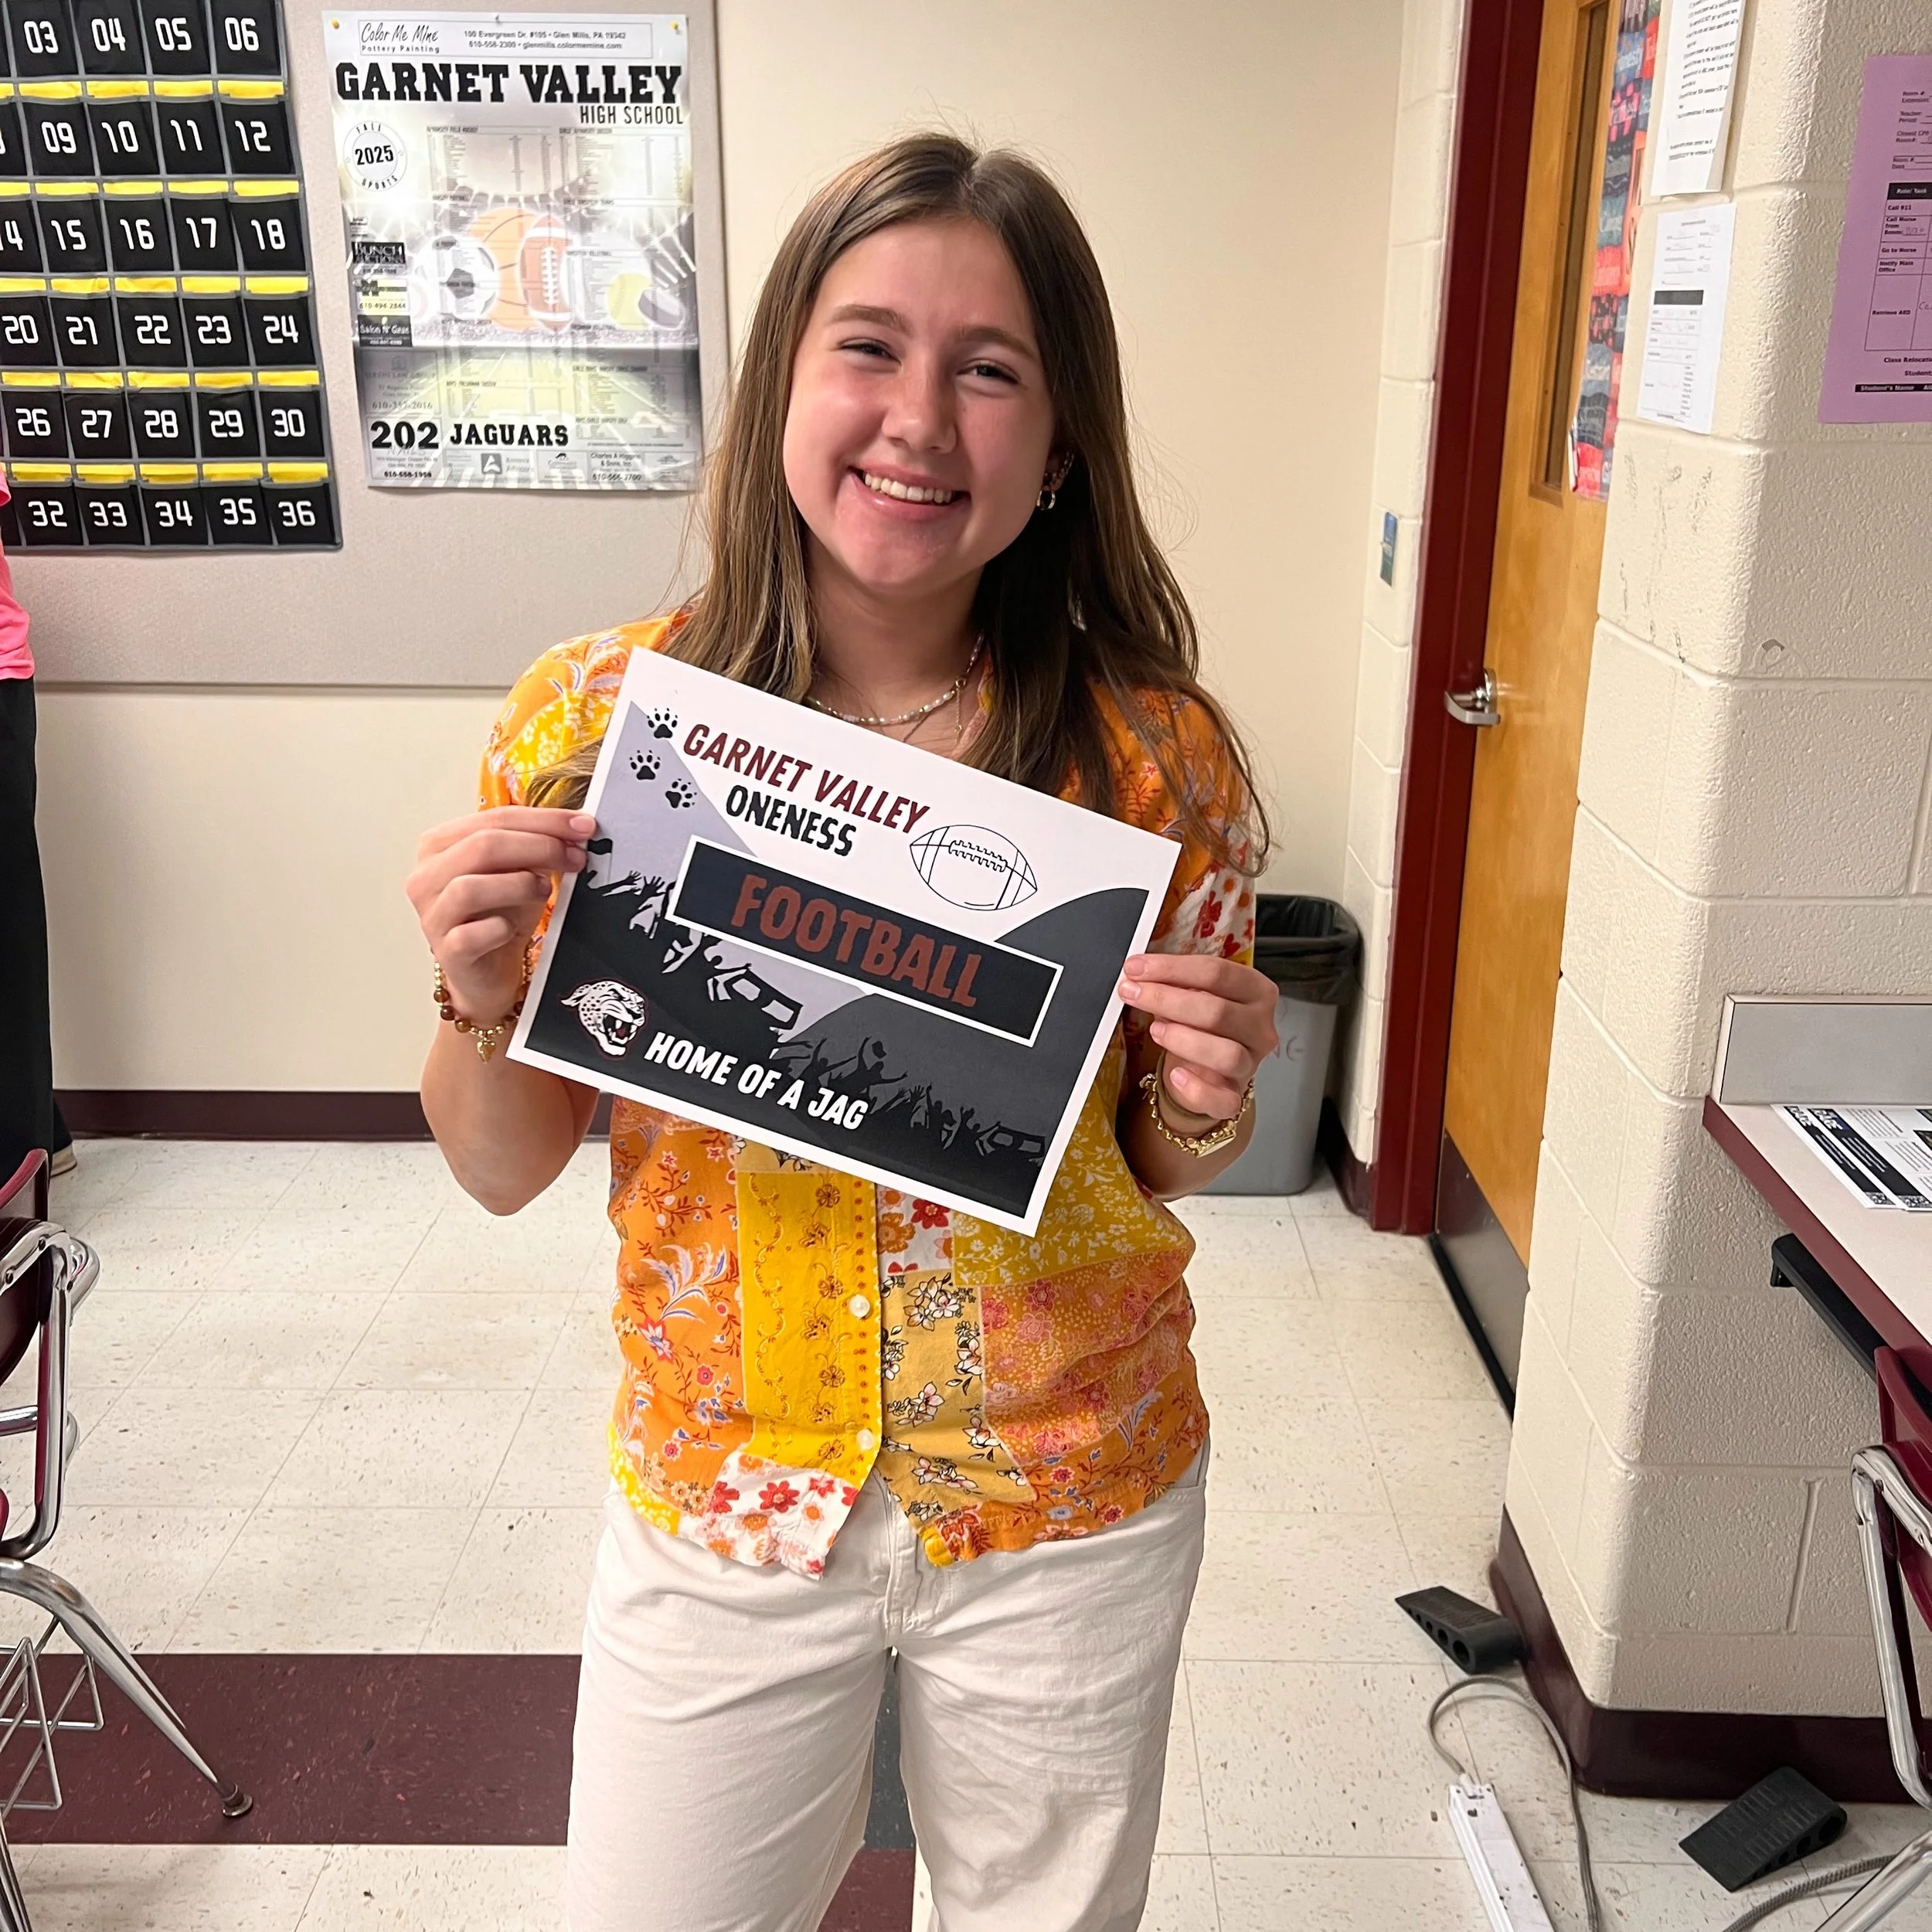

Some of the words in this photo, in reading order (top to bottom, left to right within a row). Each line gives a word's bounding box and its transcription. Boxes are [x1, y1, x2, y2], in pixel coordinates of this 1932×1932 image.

[24, 22, 58, 53] 03
[92, 19, 125, 51] 04
[155, 18, 192, 50] 05
[225, 18, 259, 50] 06
[362, 22, 389, 43] Color
[392, 25, 408, 42] Me
[400, 45, 440, 53] Painting
[335, 62, 509, 103] GARNET
[519, 65, 682, 104] VALLEY
[580, 106, 616, 124] HIGH
[624, 107, 683, 124] SCHOOL
[42, 122, 76, 153] 09
[102, 121, 138, 152] 10
[171, 120, 202, 151] 11
[235, 121, 270, 151] 12
[355, 145, 394, 165] 2025
[0, 221, 22, 250] 4
[51, 220, 86, 250] 15
[120, 219, 154, 249] 16
[186, 218, 216, 247] 17
[251, 219, 285, 250] 18
[2, 315, 38, 344] 20
[66, 317, 97, 345] 21
[134, 315, 171, 344] 22
[196, 316, 231, 343] 23
[264, 315, 298, 343] 24
[16, 409, 50, 436] 26
[81, 410, 111, 437] 27
[145, 410, 178, 437] 28
[209, 410, 243, 437] 29
[271, 410, 304, 437] 30
[370, 420, 439, 449] 202
[450, 423, 569, 446] JAGUARS
[29, 501, 67, 526] 32
[90, 502, 127, 526] 33
[155, 501, 192, 526] 34
[220, 498, 256, 525] 35
[278, 502, 315, 526] 36
[683, 724, 812, 792] GARNET
[815, 770, 930, 833] VALLEY
[726, 784, 856, 856] ONENESS
[730, 874, 982, 1008] FOOTBALL
[644, 1031, 738, 1086] HOME
[737, 1063, 782, 1099] OF
[777, 1080, 804, 1110] A
[808, 1087, 869, 1130] JAG
